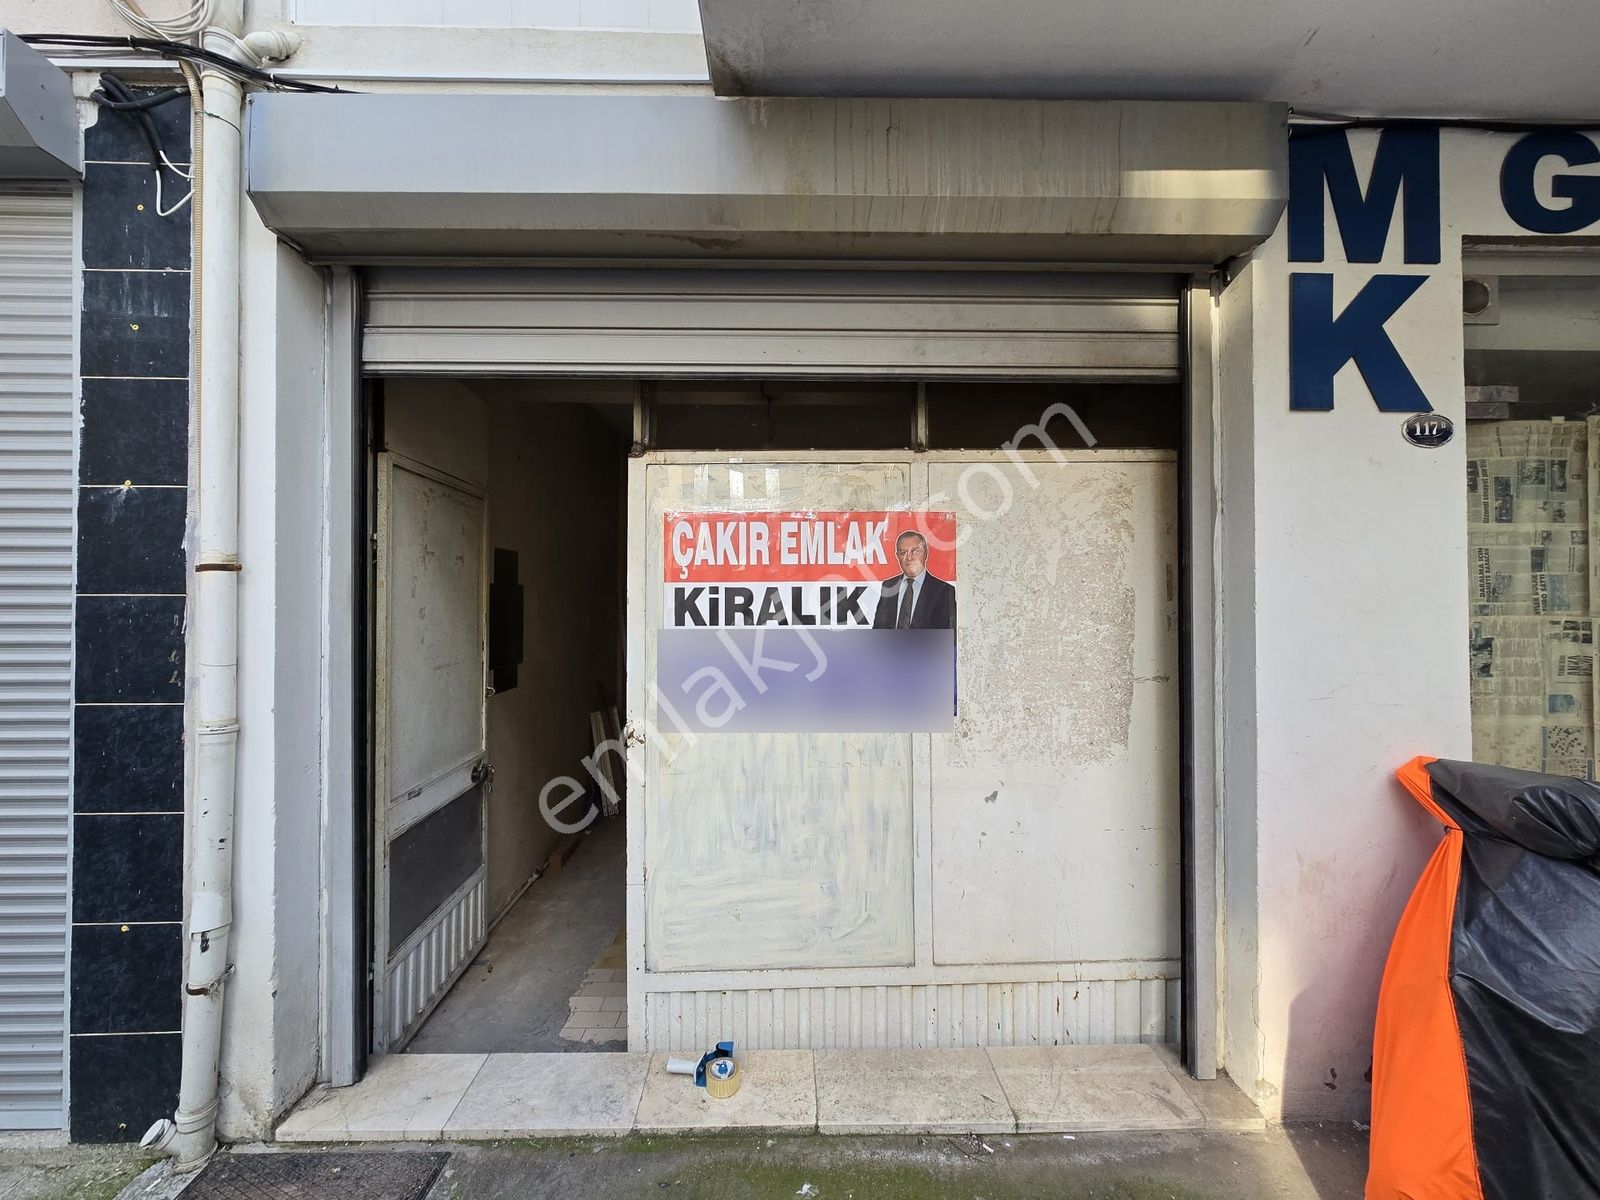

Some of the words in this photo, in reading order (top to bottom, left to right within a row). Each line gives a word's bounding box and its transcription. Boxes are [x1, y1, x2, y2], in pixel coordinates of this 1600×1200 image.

[1287, 126, 1441, 264] M
[1500, 130, 1600, 234] G
[1289, 272, 1434, 412] K
[1414, 421, 1438, 436] 117
[672, 520, 771, 579] ÇAKIR
[780, 520, 888, 566] EMLAK
